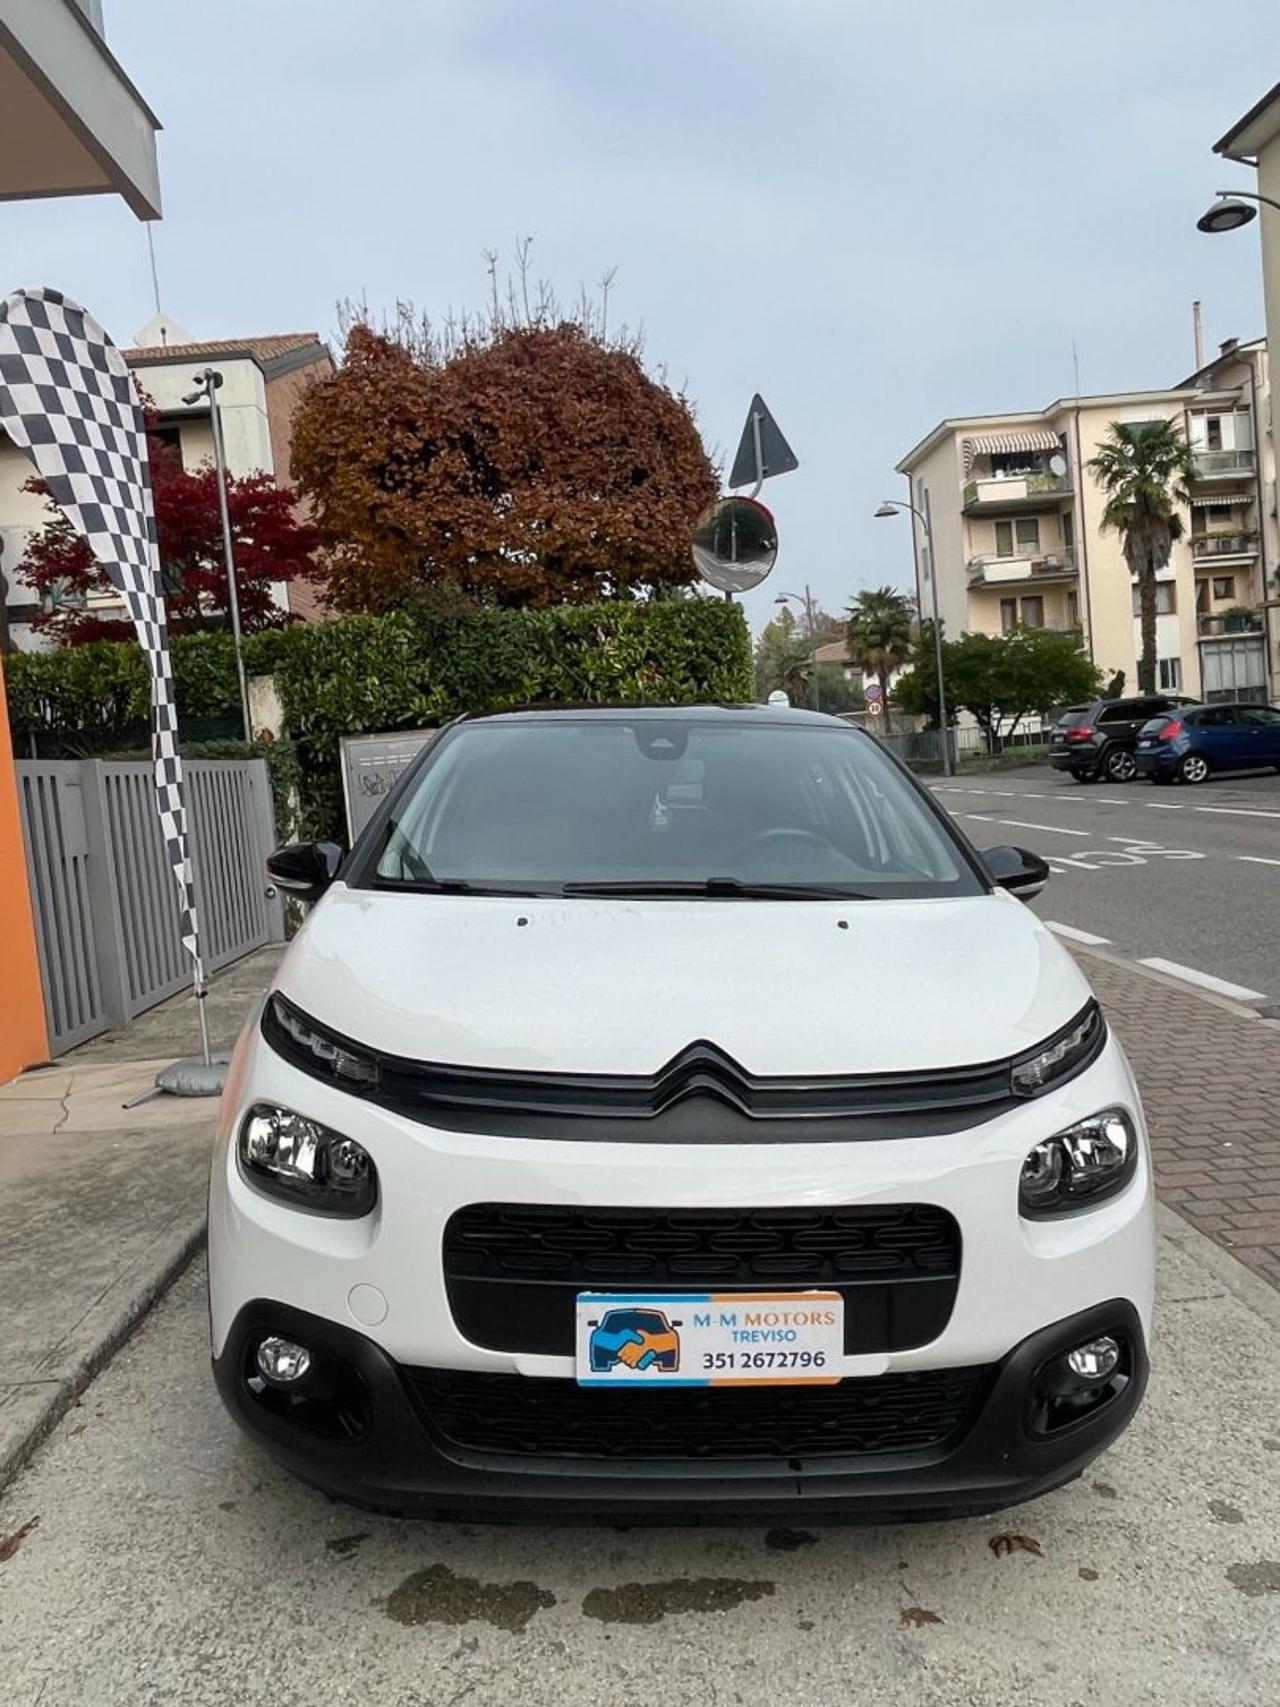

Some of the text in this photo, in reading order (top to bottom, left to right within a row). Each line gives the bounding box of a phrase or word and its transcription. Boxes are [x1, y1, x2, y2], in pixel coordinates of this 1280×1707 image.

[744, 1311, 836, 1326] MOTORS
[732, 1330, 797, 1343] TREVISO
[703, 1350, 826, 1369] 351 2672796
